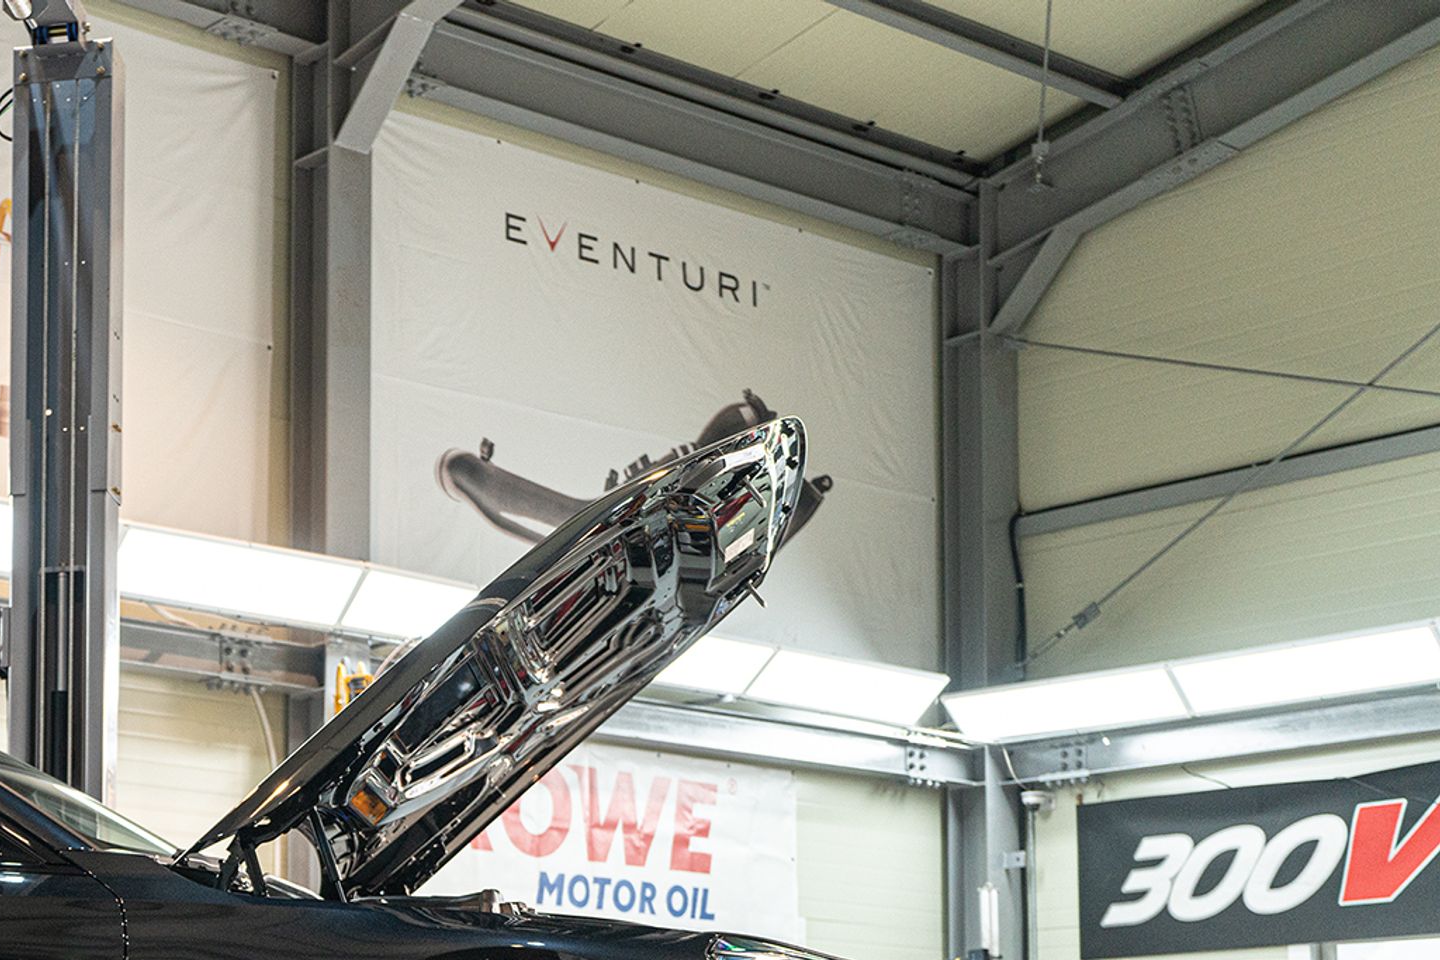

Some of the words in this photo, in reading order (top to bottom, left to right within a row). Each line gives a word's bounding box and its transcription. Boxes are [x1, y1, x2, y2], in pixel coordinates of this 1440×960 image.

[505, 212, 758, 307] EVENTURI
[470, 764, 718, 874] OWE
[1099, 794, 1440, 929] 300V
[536, 871, 657, 915] MOTOR
[666, 884, 715, 921] OIL
